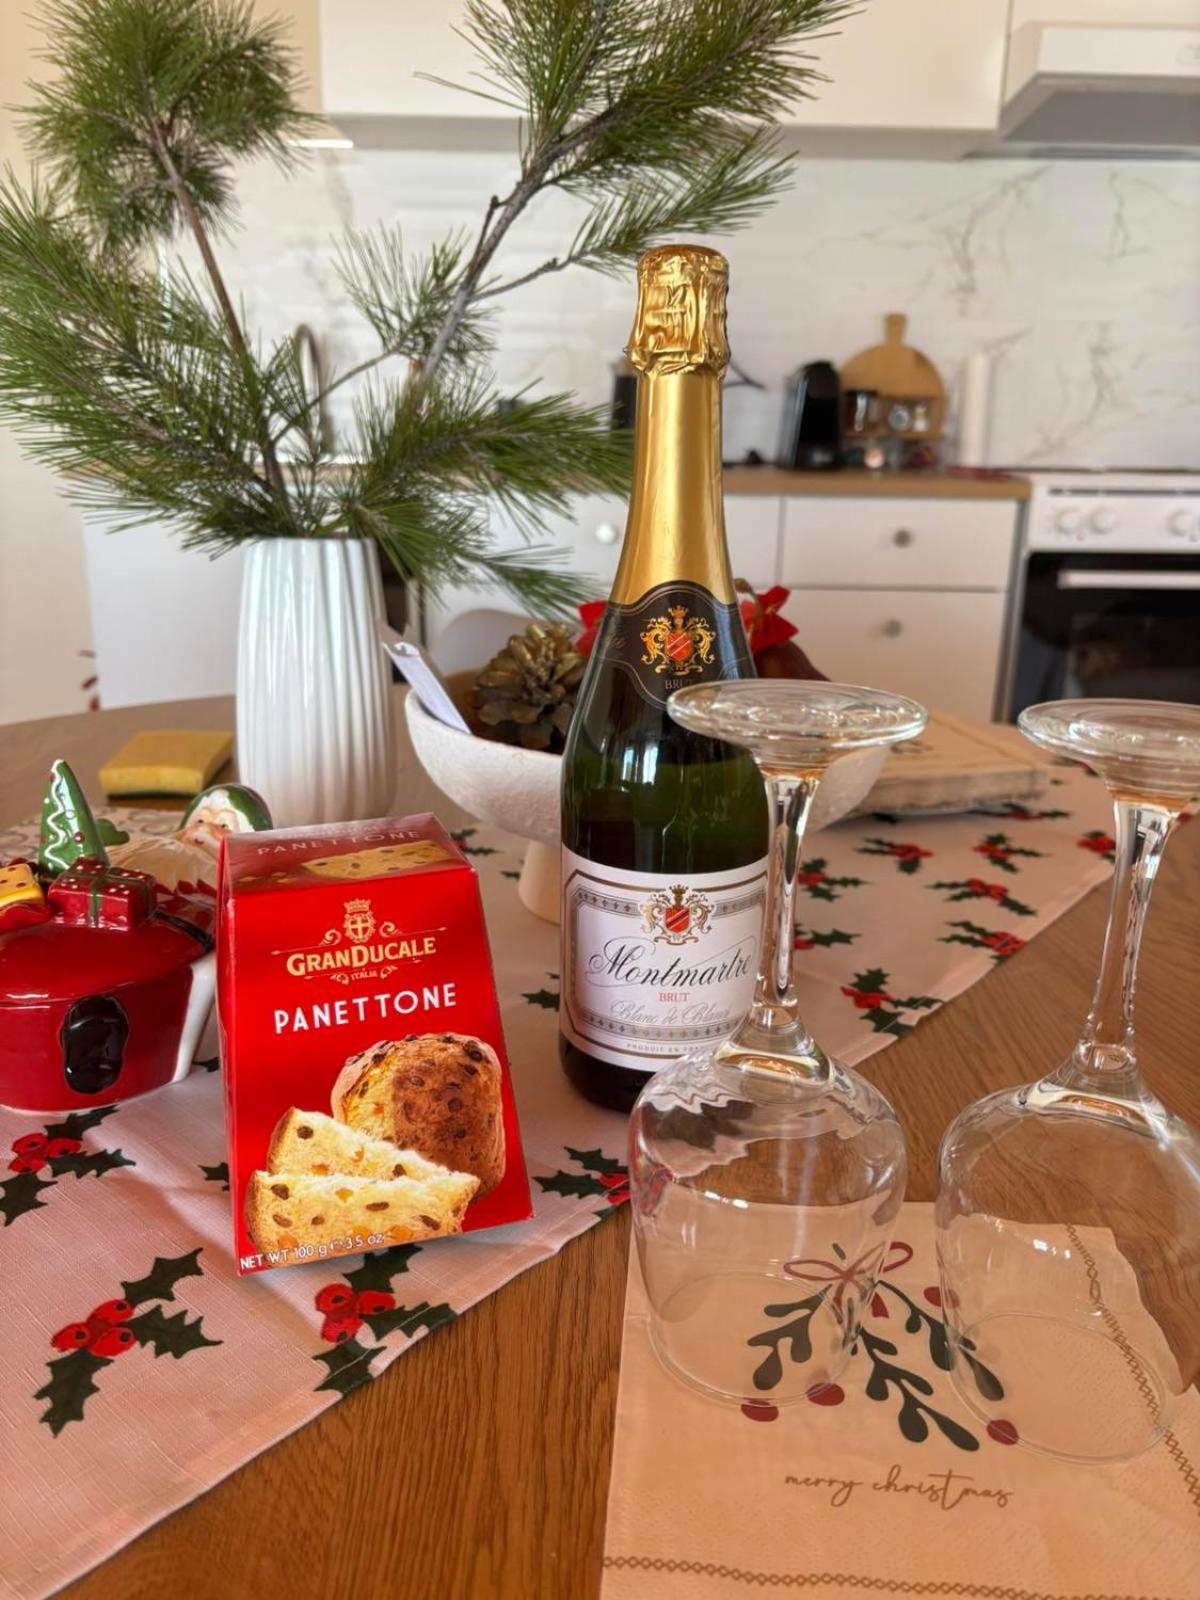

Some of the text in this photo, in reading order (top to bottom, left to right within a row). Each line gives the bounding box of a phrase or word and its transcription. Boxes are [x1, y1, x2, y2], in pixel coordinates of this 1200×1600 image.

[257, 830, 421, 856] PANETTONE
[585, 936, 757, 988] Montmartre
[274, 983, 457, 1035] PANETTONE
[659, 992, 690, 1002] BRUT
[610, 999, 659, 1024] Blanc
[661, 1006, 681, 1025] de
[240, 1254, 264, 1270] NET
[269, 1249, 288, 1264] WT
[294, 1246, 315, 1259] 100
[319, 1245, 328, 1257] g
[785, 1464, 1014, 1510] merry christmas
